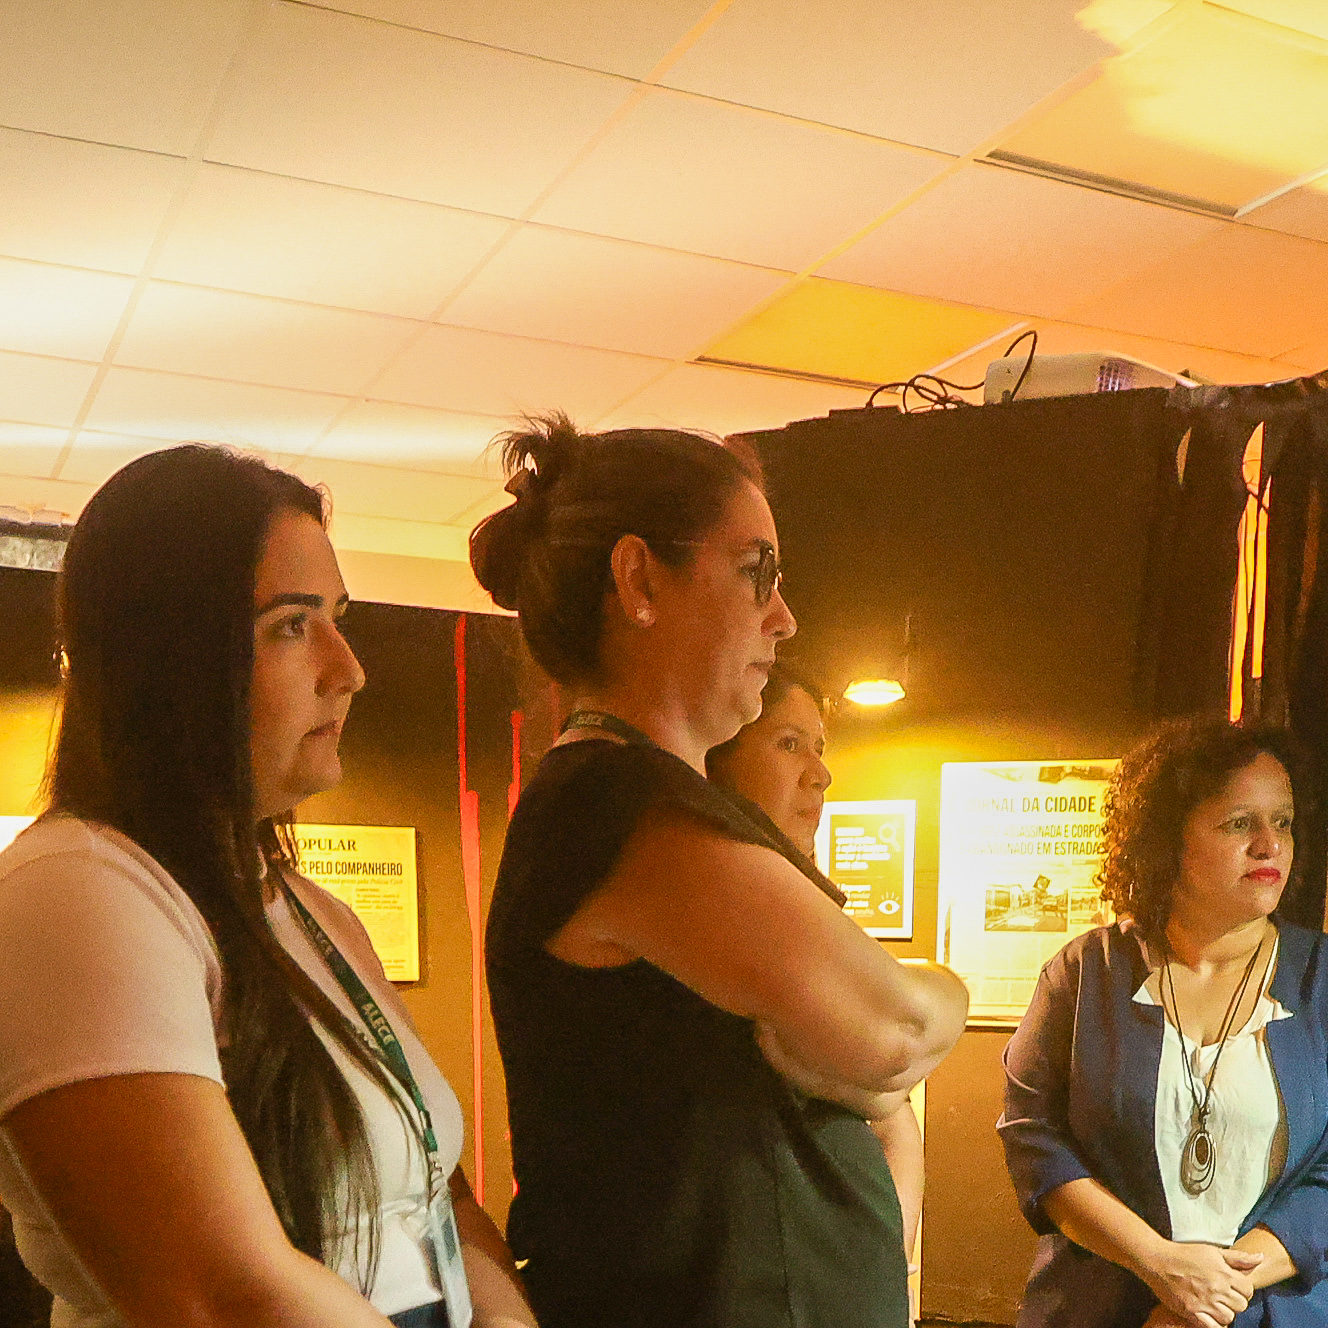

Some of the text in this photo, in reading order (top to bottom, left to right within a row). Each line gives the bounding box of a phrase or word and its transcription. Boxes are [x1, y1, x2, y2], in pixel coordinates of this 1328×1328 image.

[1022, 796, 1040, 813] DA
[1045, 795, 1097, 813] CIDADE
[1071, 824, 1101, 838] CORPO
[1037, 841, 1051, 856] EM
[309, 861, 333, 875] PELO
[335, 861, 403, 876] COMPANHEIRO
